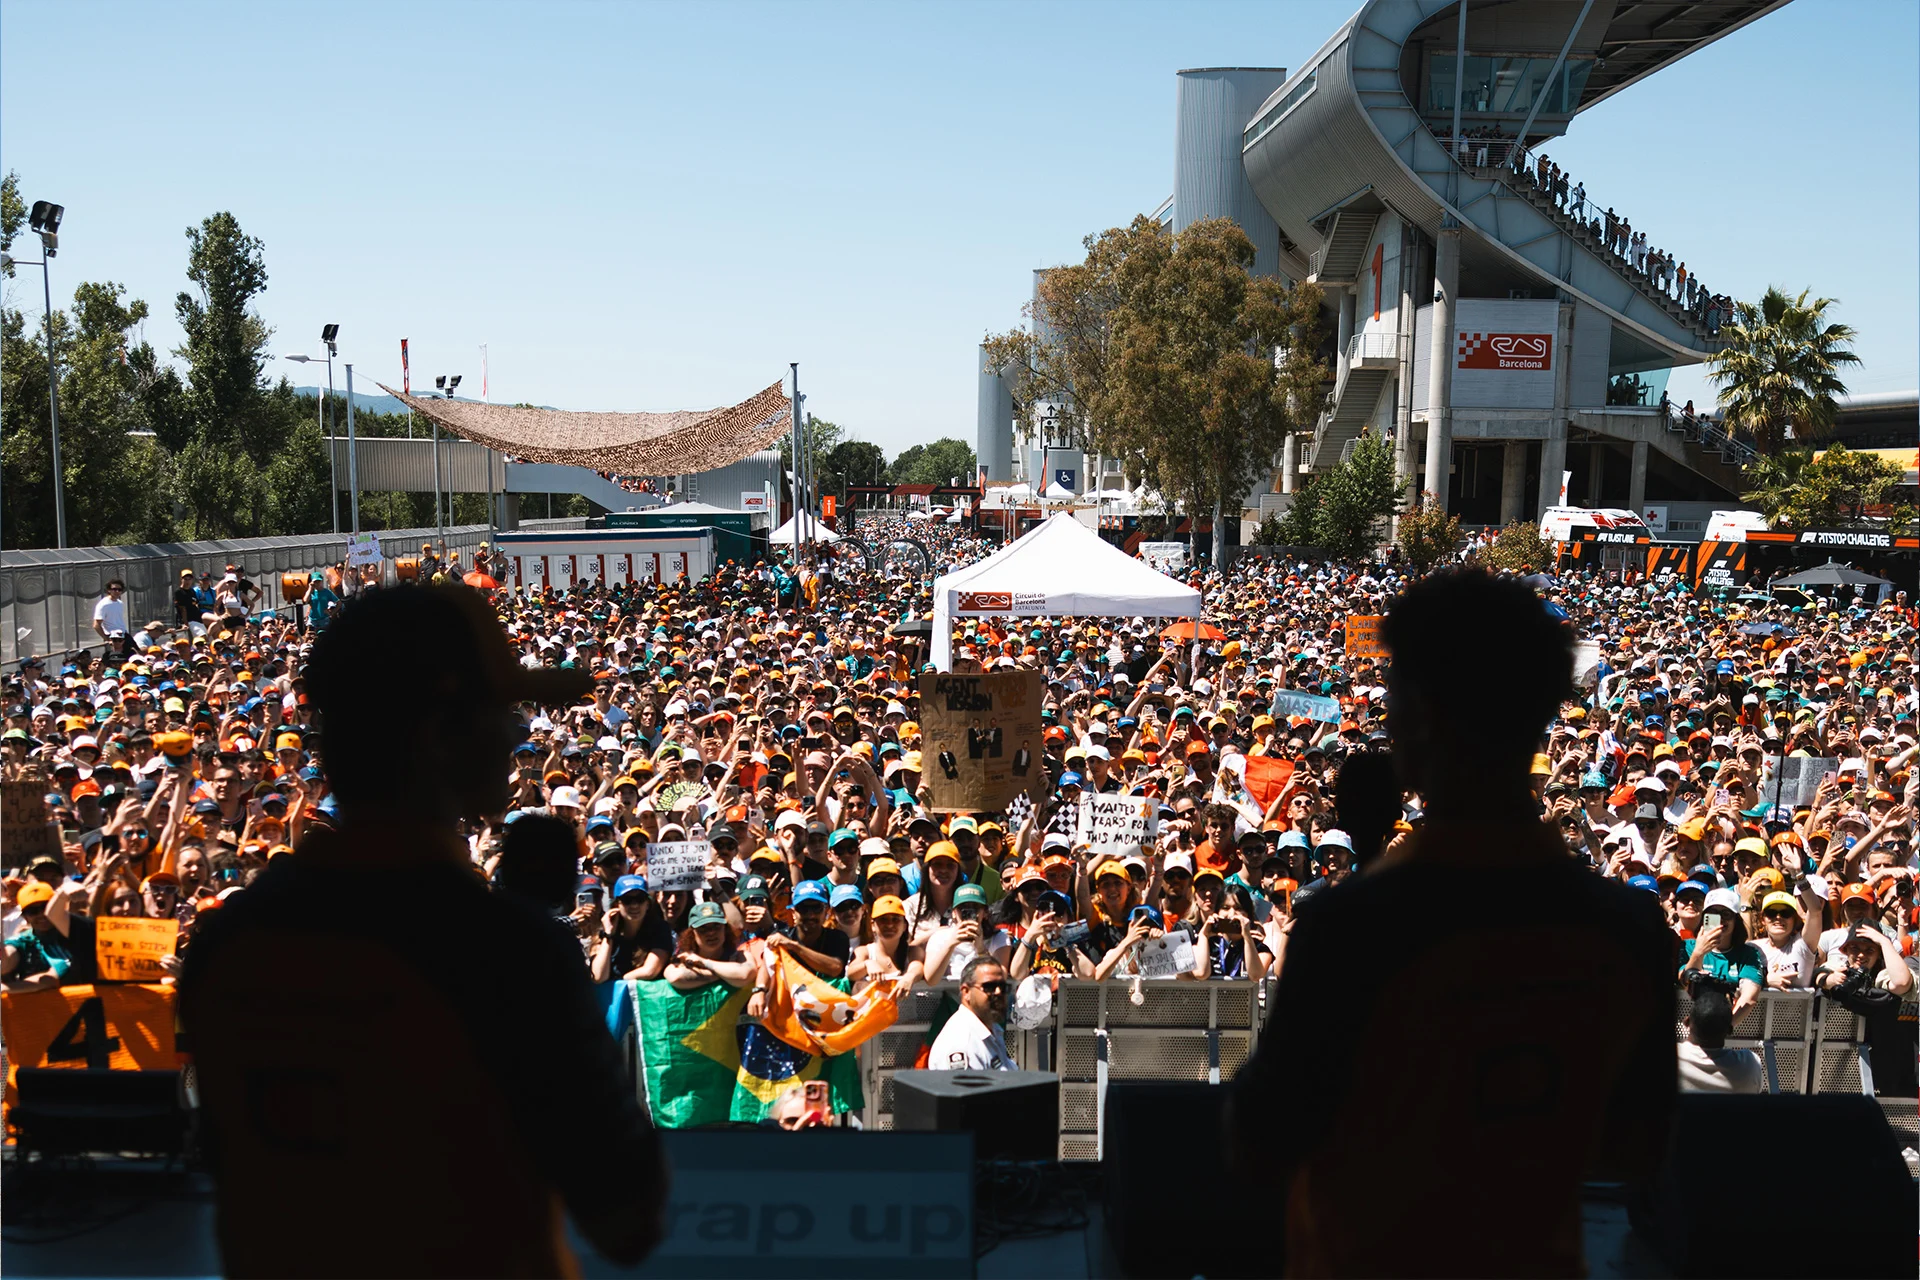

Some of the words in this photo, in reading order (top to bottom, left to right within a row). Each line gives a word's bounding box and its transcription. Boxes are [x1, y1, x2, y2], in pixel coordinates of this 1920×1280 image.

[1372, 243, 1384, 321] 1
[1500, 360, 1542, 368] Barcelona
[1818, 532, 1846, 544] PITSTOP
[1847, 534, 1890, 546] CHALLENGE
[1708, 569, 1730, 577] PITSTOP
[1704, 576, 1734, 586] CHALLENGE
[936, 678, 980, 698] AGENT
[1091, 802, 1136, 815] WAITED
[1090, 816, 1126, 827] YEARS
[1132, 820, 1150, 831] FOR
[1086, 830, 1108, 844] THIS
[1114, 834, 1158, 845] MOMENT
[650, 846, 674, 856] LANDO
[680, 845, 689, 854] IF
[693, 844, 708, 853] YOU
[682, 855, 704, 864] YOUR
[661, 879, 674, 887] YOU
[100, 922, 105, 931] I
[104, 955, 128, 971] THE
[46, 996, 121, 1070] 4
[667, 1200, 815, 1254] rap
[850, 1202, 964, 1255] up
